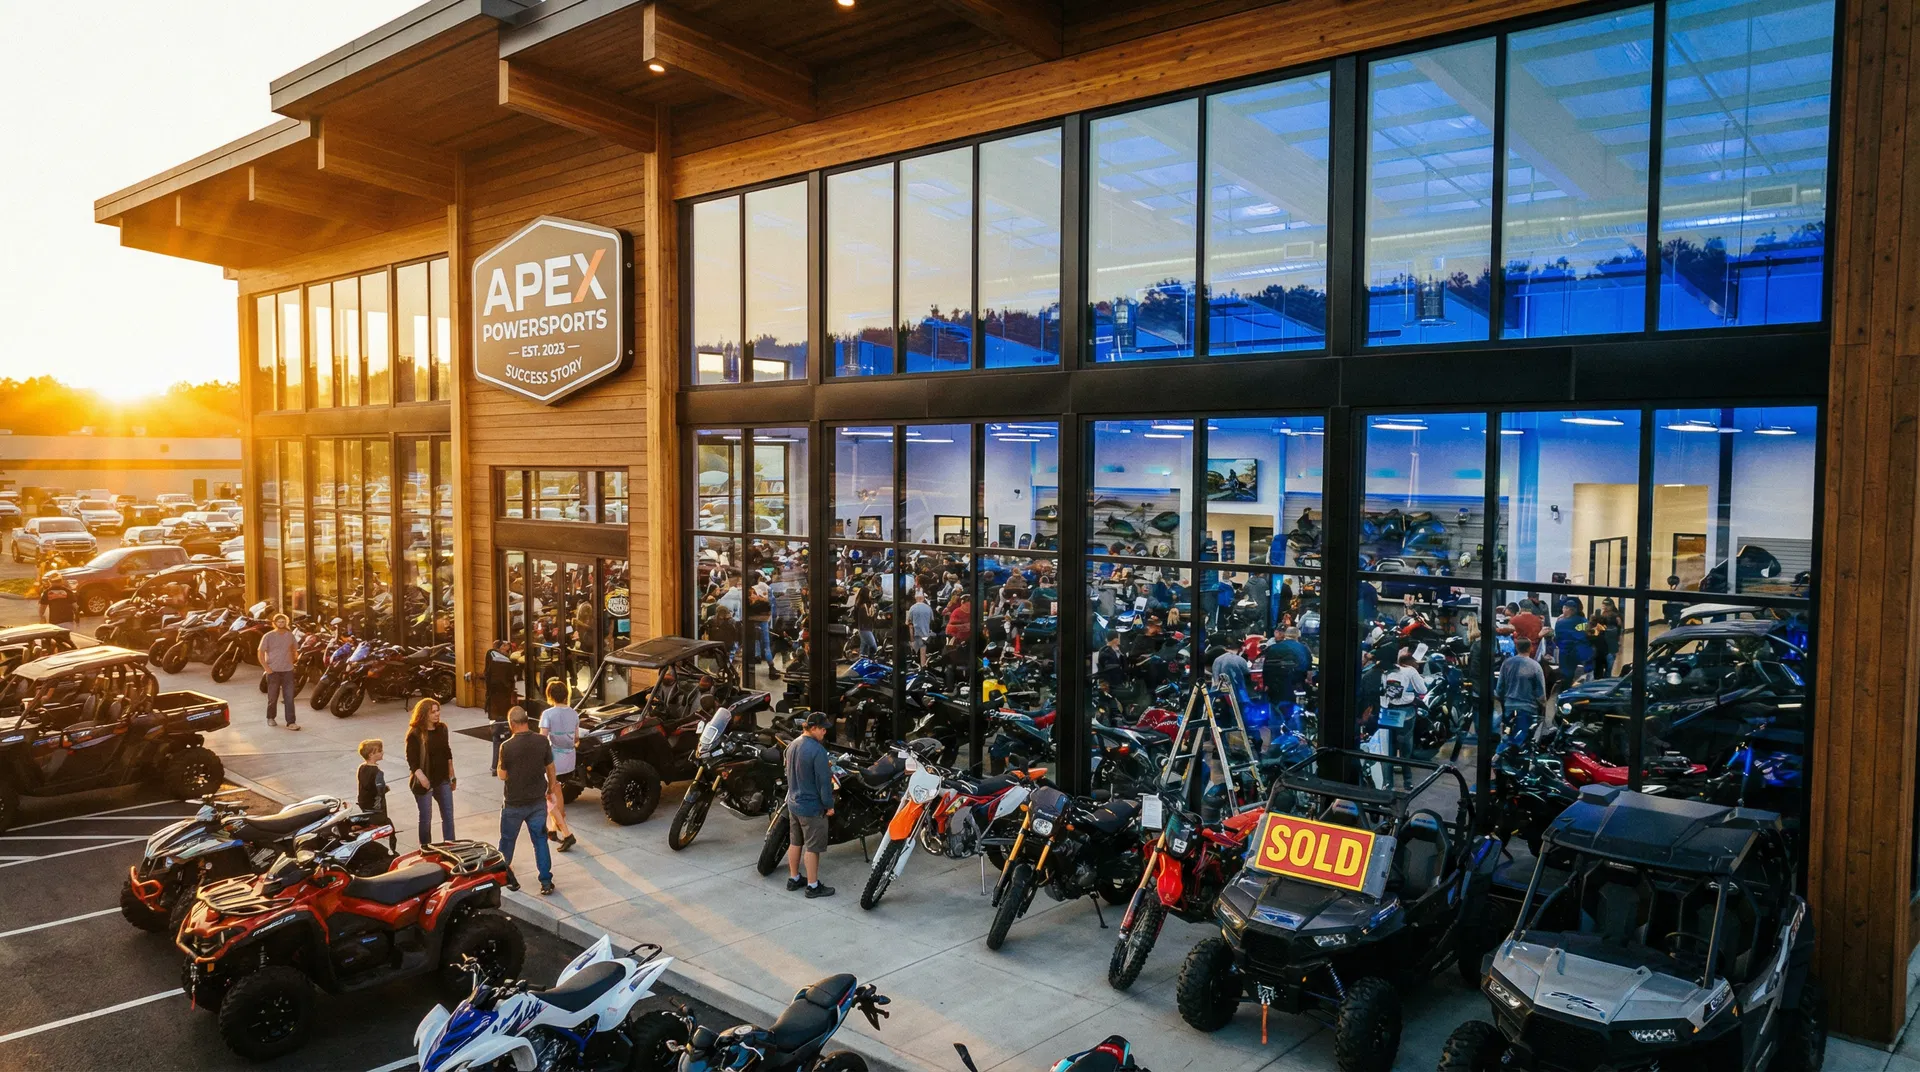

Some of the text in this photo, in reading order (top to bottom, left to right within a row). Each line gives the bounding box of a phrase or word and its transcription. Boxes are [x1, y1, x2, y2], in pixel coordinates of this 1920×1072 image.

[482, 249, 607, 317] APEX
[483, 308, 608, 343] POWERSPORTS
[521, 342, 566, 358] EST. 2023
[505, 356, 583, 385] SUCCESS STORY
[1265, 824, 1363, 877] SOLD
